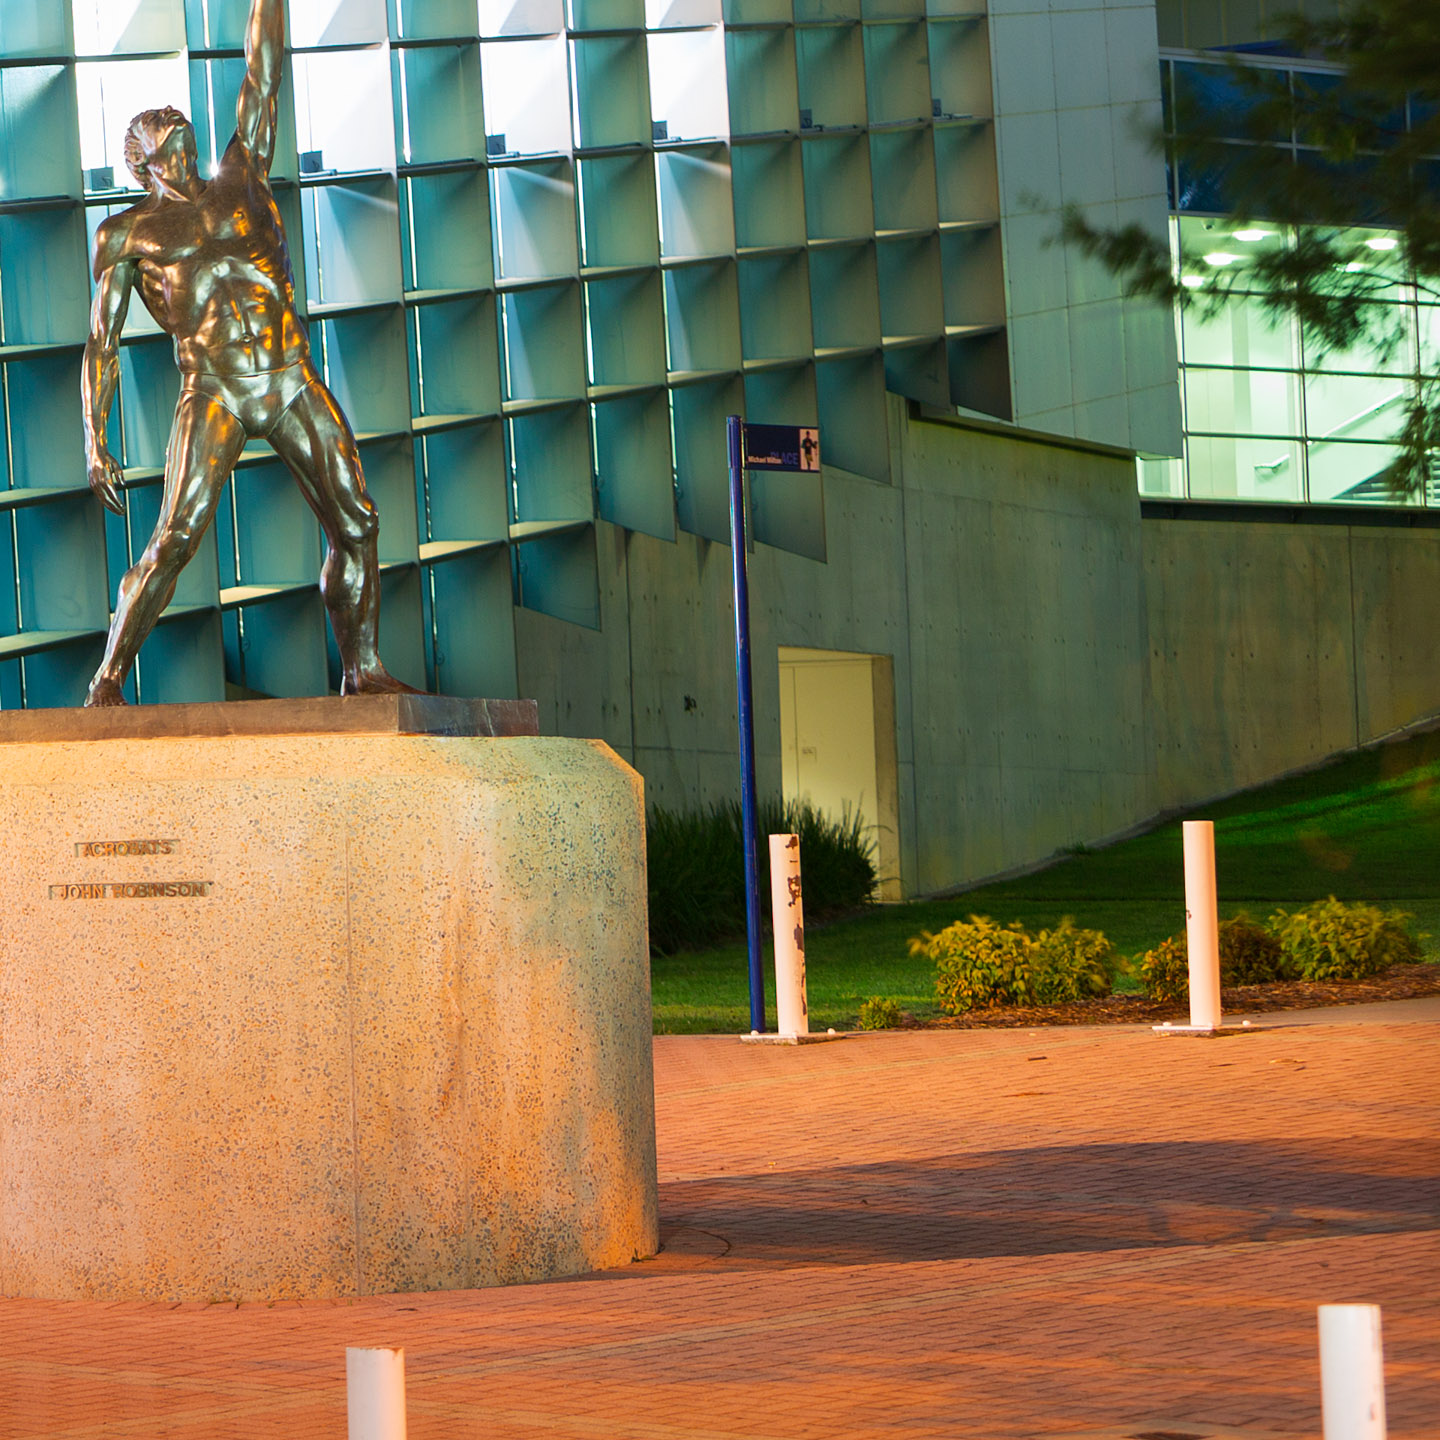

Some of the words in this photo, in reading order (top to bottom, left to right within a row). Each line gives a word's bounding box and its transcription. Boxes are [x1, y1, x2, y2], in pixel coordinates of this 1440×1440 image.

[82, 840, 173, 857] ACROBATS
[60, 884, 104, 900] JOHN
[111, 882, 206, 899] ROBINSON
